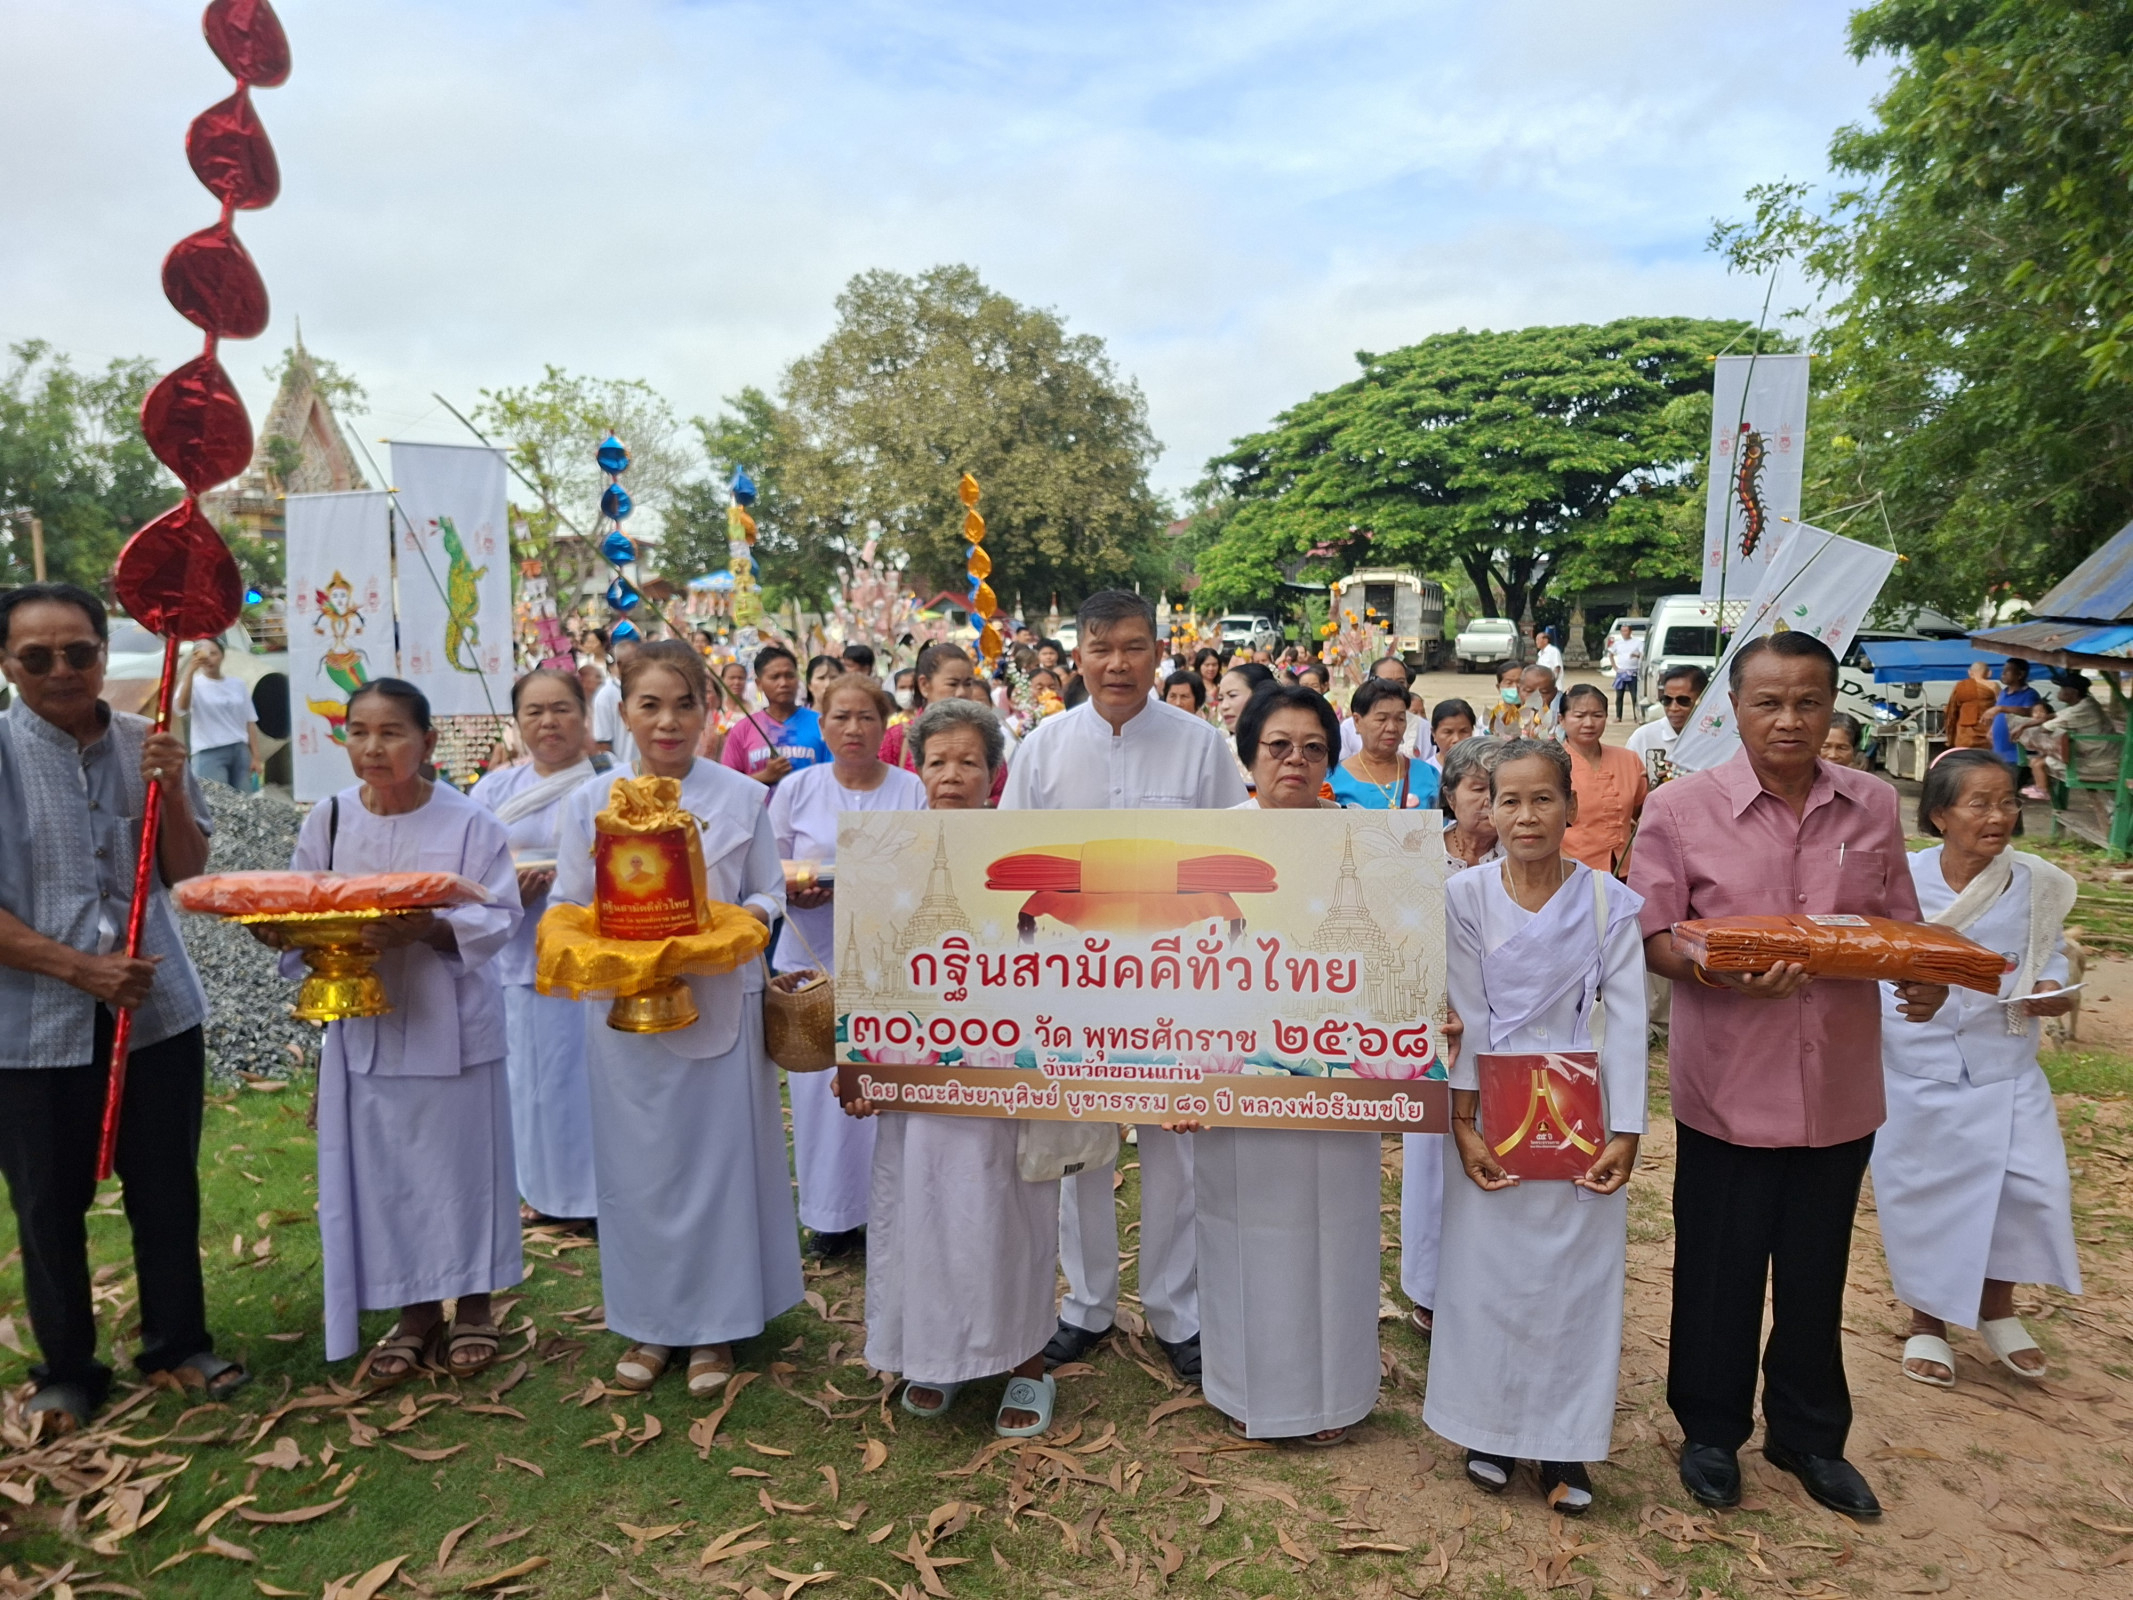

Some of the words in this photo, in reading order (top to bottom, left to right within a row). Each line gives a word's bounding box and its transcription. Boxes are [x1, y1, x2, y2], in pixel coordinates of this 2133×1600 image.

[911, 923, 1357, 1002] กฐินสามัคคีทั่วไทย
[853, 1016, 1021, 1051] ๓๐,๐๐๐
[1034, 1014, 1072, 1048] วัด
[1083, 1016, 1257, 1061] พุทธศักราช
[1272, 1018, 1428, 1058] ๒๕๖๘
[1043, 1057, 1202, 1080] จังหวัดขอนแก่น
[859, 1077, 898, 1099] โดย
[903, 1081, 1059, 1112] คณะศิษยานุศิษย์
[1066, 1093, 1167, 1116] บูชาธรรม
[1176, 1096, 1208, 1113] ๘๑
[1217, 1090, 1232, 1113] ปี
[1241, 1092, 1422, 1119] หลวงพ่อธัมมชโย
